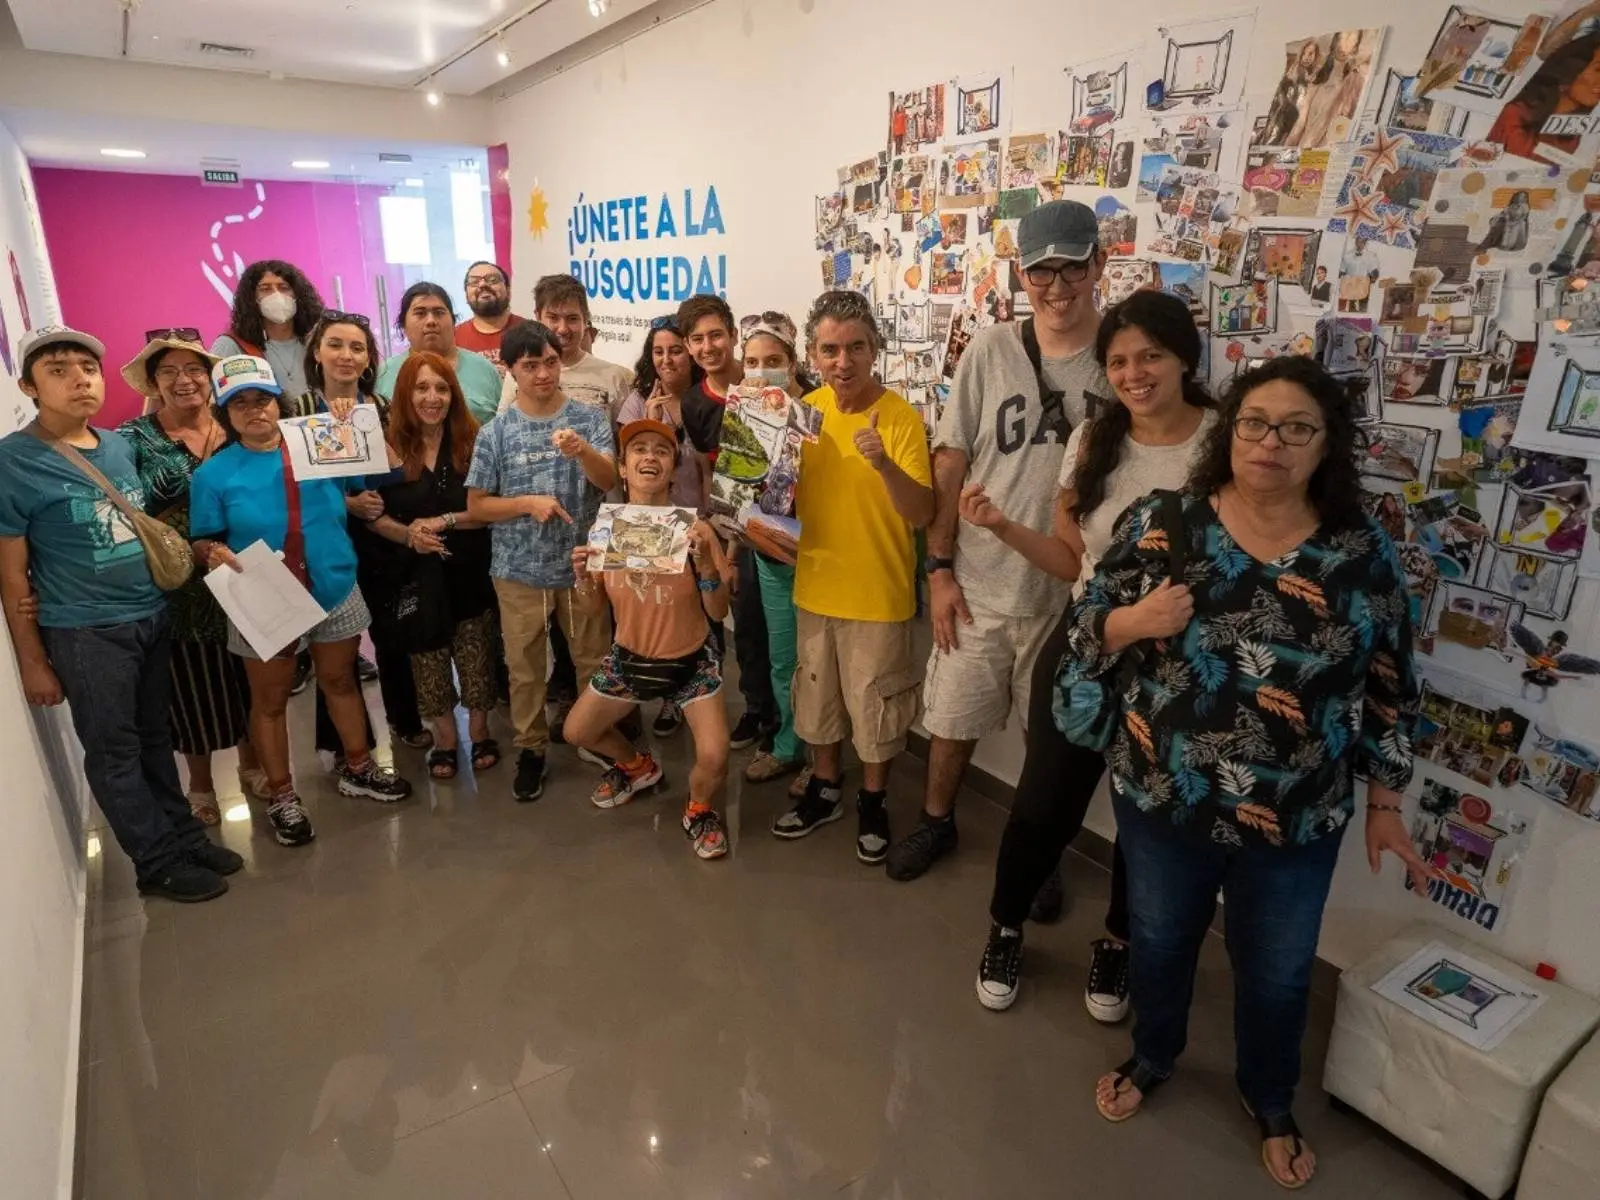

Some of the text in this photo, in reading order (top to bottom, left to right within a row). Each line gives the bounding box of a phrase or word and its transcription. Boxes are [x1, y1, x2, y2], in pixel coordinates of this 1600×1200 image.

[207, 172, 236, 181] SALIDA
[567, 185, 726, 256] ¡ÚNETE A LA
